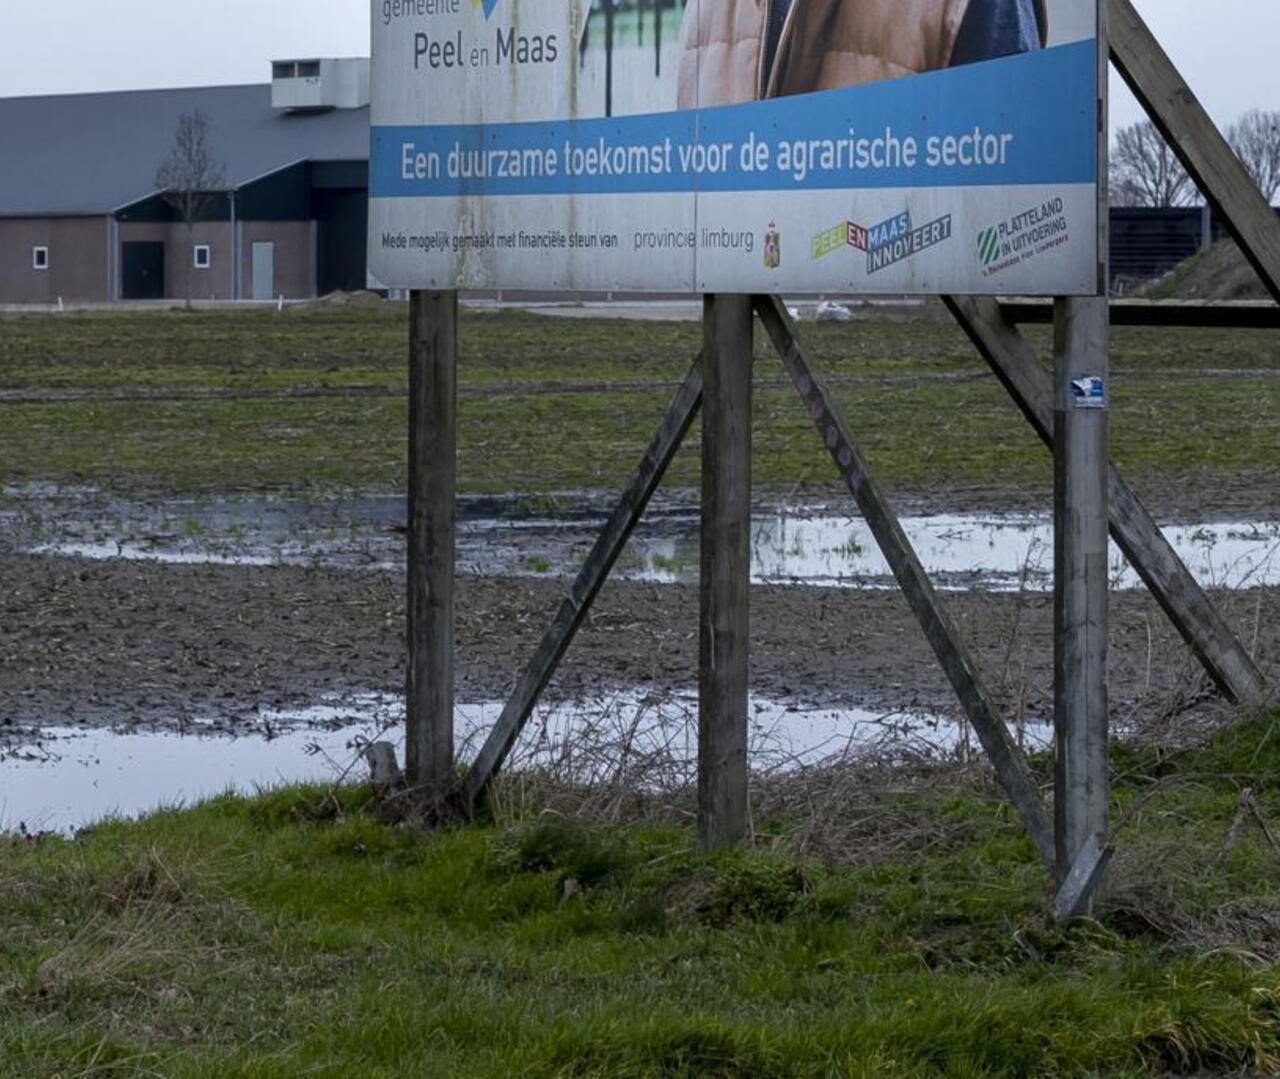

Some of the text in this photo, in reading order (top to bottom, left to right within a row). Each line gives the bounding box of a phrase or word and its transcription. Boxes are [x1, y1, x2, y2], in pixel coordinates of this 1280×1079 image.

[414, 27, 558, 69] Peel en Maas
[402, 125, 1013, 181] Een duurzame toekomst voor de agrarische sector
[812, 214, 907, 257] PEEL EN MAAS
[998, 197, 1063, 239] PLATTELAND
[1011, 216, 1067, 252] UITVOERING
[382, 231, 407, 249] Mede
[409, 231, 450, 252] mogelijk
[452, 231, 495, 252] gemaakt
[496, 231, 516, 248] met
[568, 231, 597, 248] steun
[599, 234, 618, 248] van
[633, 226, 754, 253] provincie limburg
